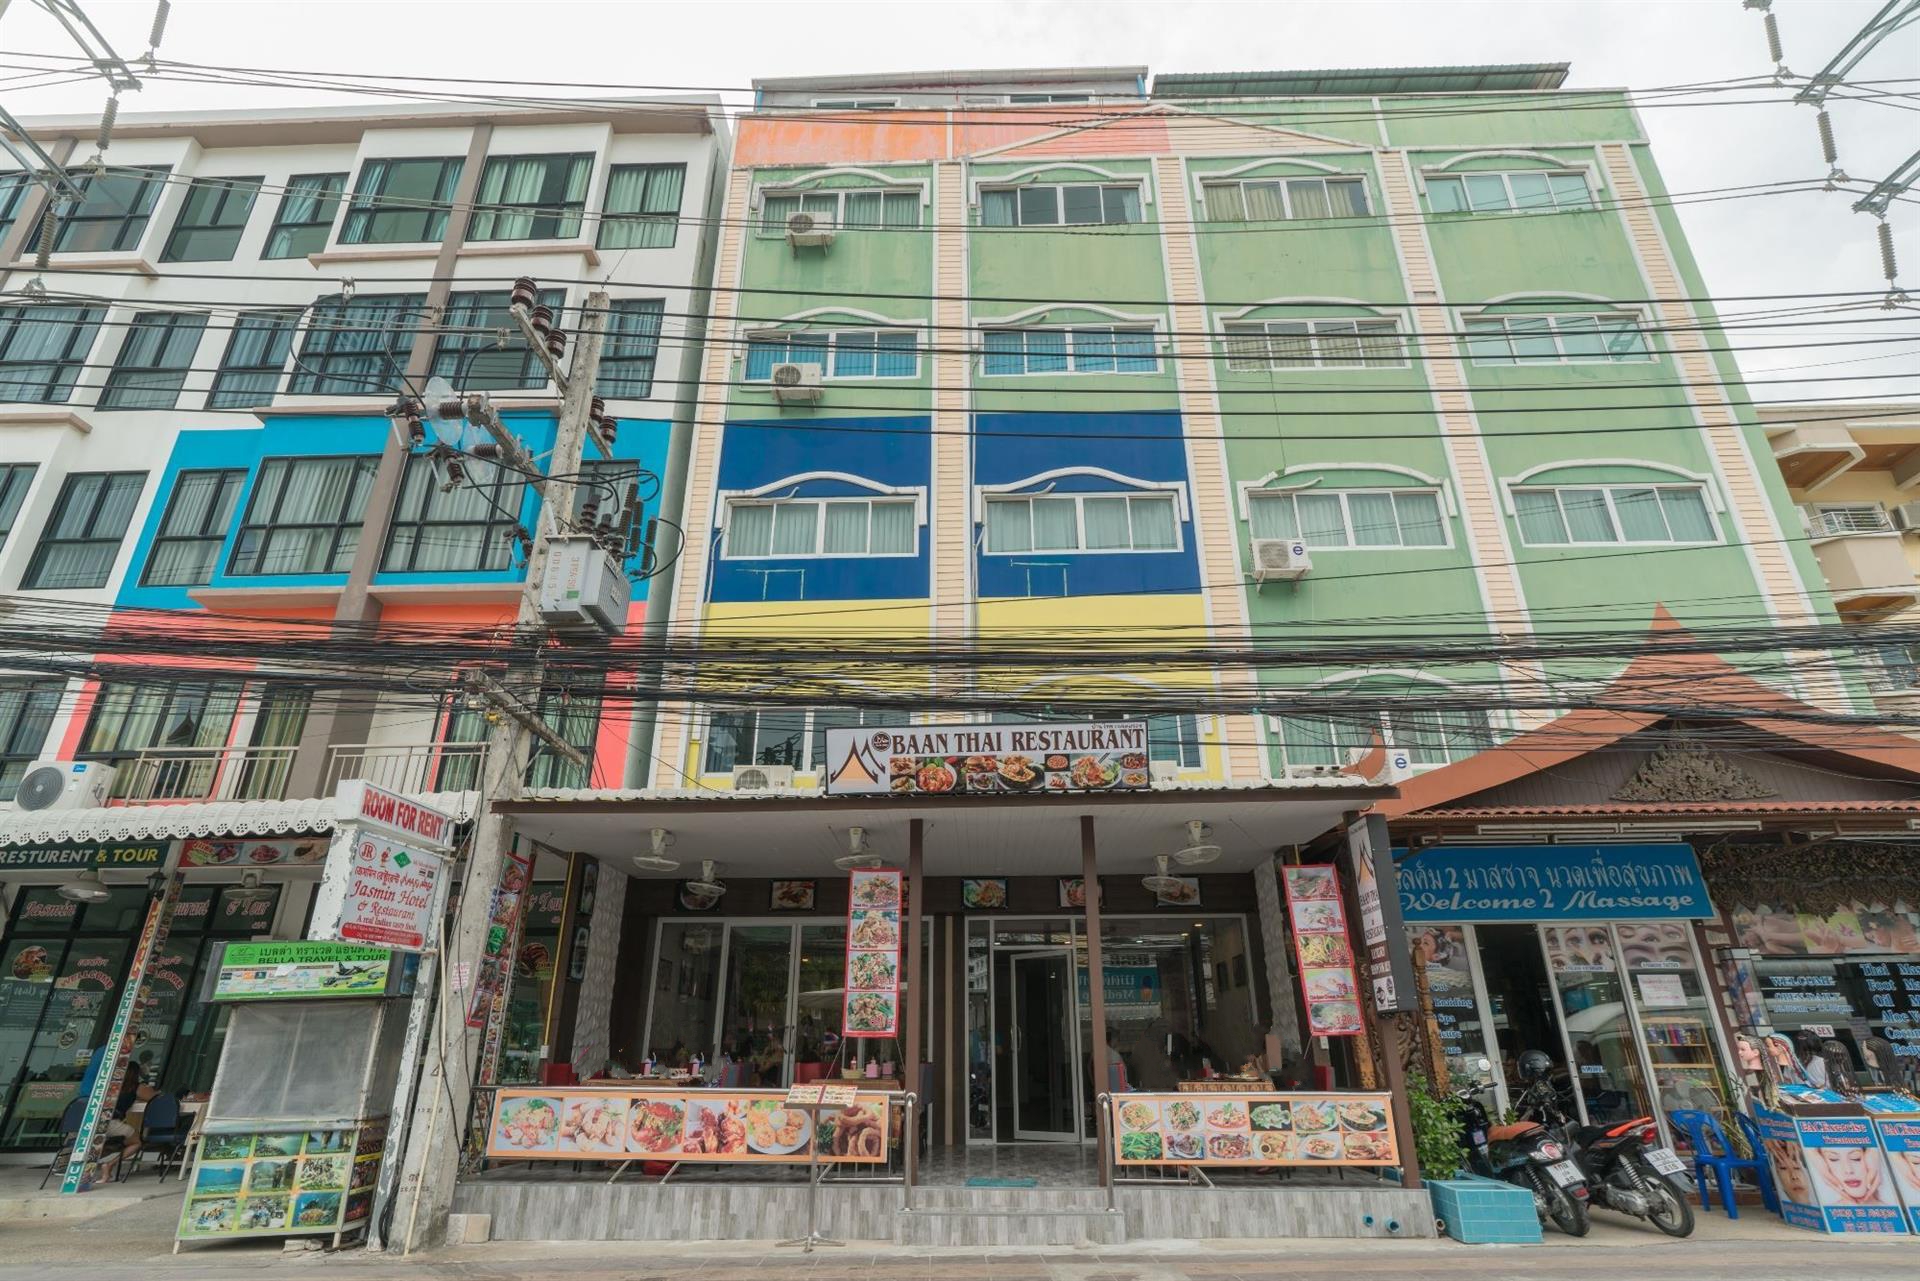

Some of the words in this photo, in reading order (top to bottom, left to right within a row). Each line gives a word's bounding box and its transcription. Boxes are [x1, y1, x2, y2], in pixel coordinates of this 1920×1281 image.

[892, 732, 948, 754] BAAN
[954, 732, 1002, 752] THAI
[1012, 729, 1145, 751] RESTAURANT
[362, 788, 396, 824] ROOM
[396, 801, 417, 832] FOR
[417, 811, 444, 840] RENT
[95, 848, 108, 862] &
[114, 848, 158, 862] TOUR
[1445, 867, 1459, 889] 2
[350, 880, 396, 902] Jasmin
[398, 890, 432, 909] Hotel
[1399, 891, 1537, 911] Welcome
[1539, 888, 1555, 909] 2
[1563, 890, 1695, 911] Massage
[370, 902, 415, 920] Restaurant
[299, 955, 340, 963] TRAVEL
[1859, 963, 1890, 976] Thai
[1866, 978, 1897, 991] Foot
[117, 982, 137, 1026] HOTEL
